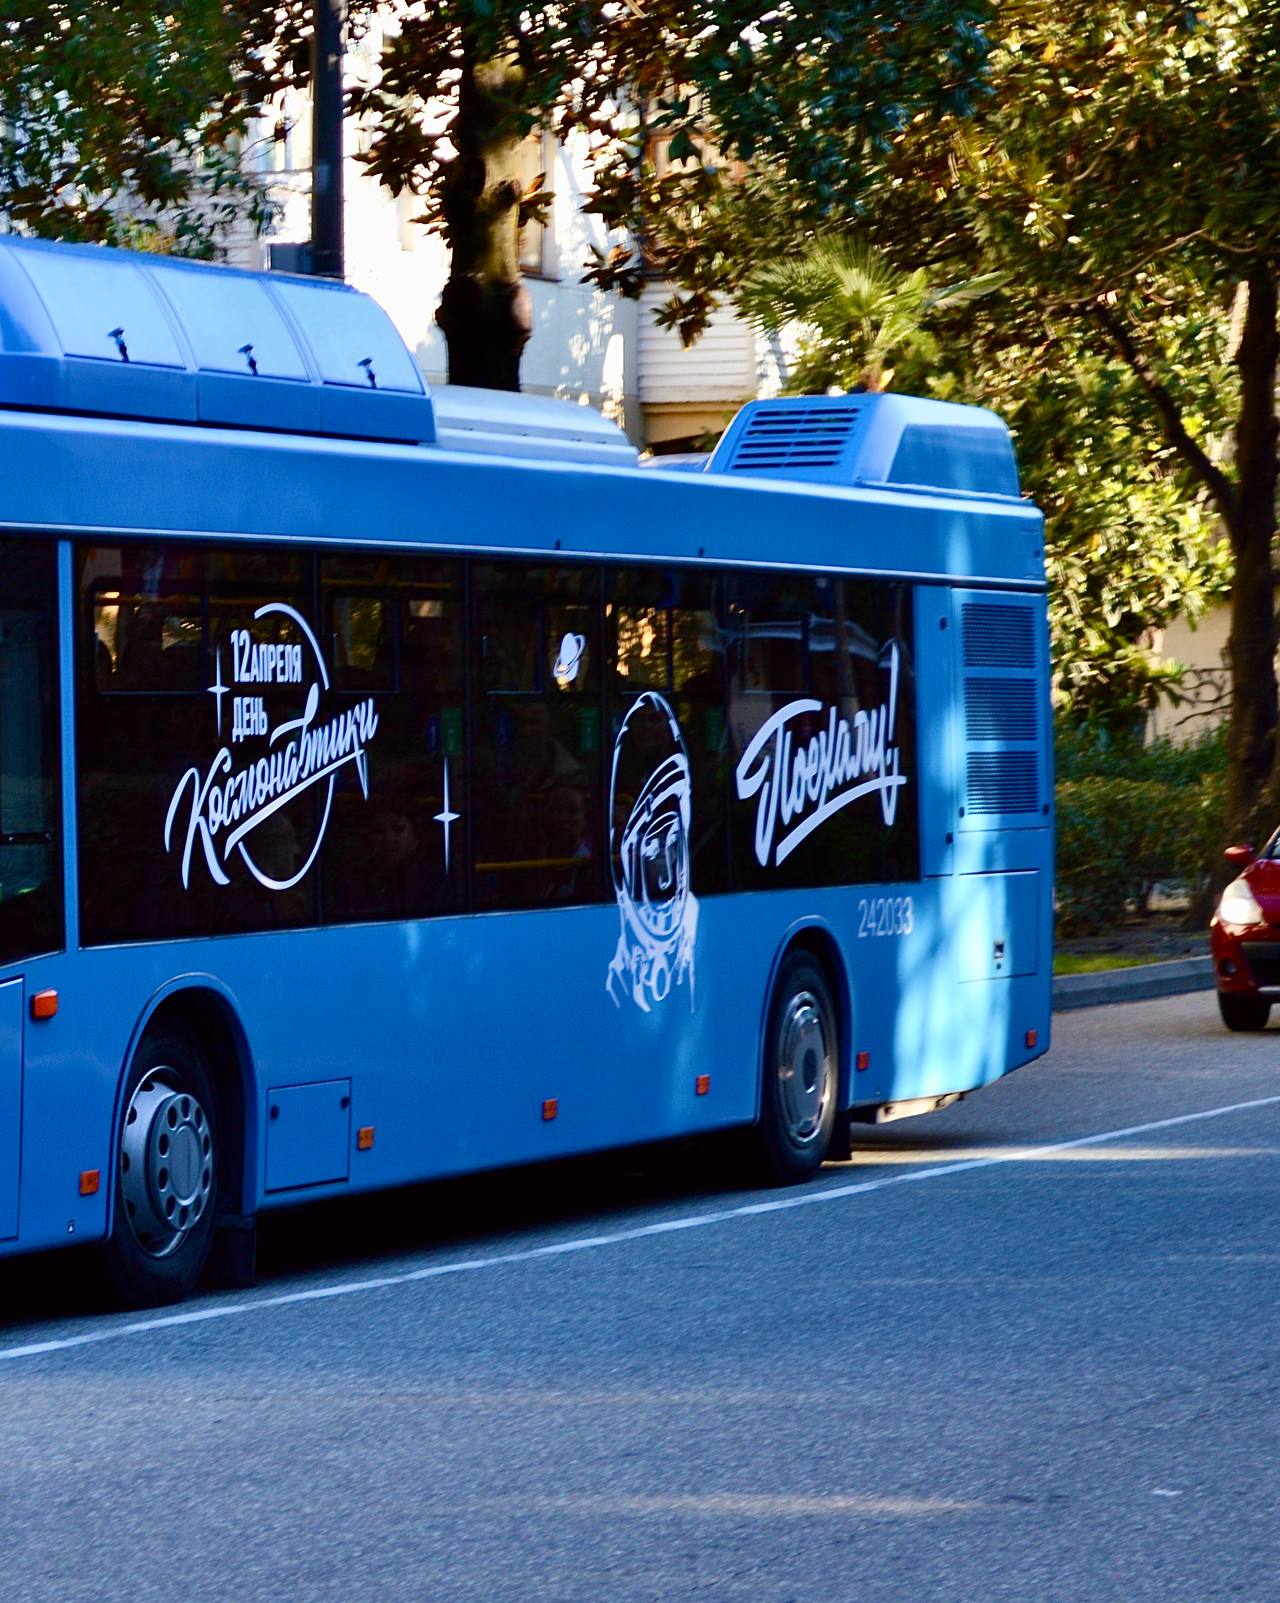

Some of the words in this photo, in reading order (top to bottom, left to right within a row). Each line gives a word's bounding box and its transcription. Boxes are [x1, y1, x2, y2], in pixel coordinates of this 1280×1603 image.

[231, 697, 268, 742] ДЕНЬ
[164, 682, 379, 890] Космонавтики
[857, 895, 914, 938] 242033
